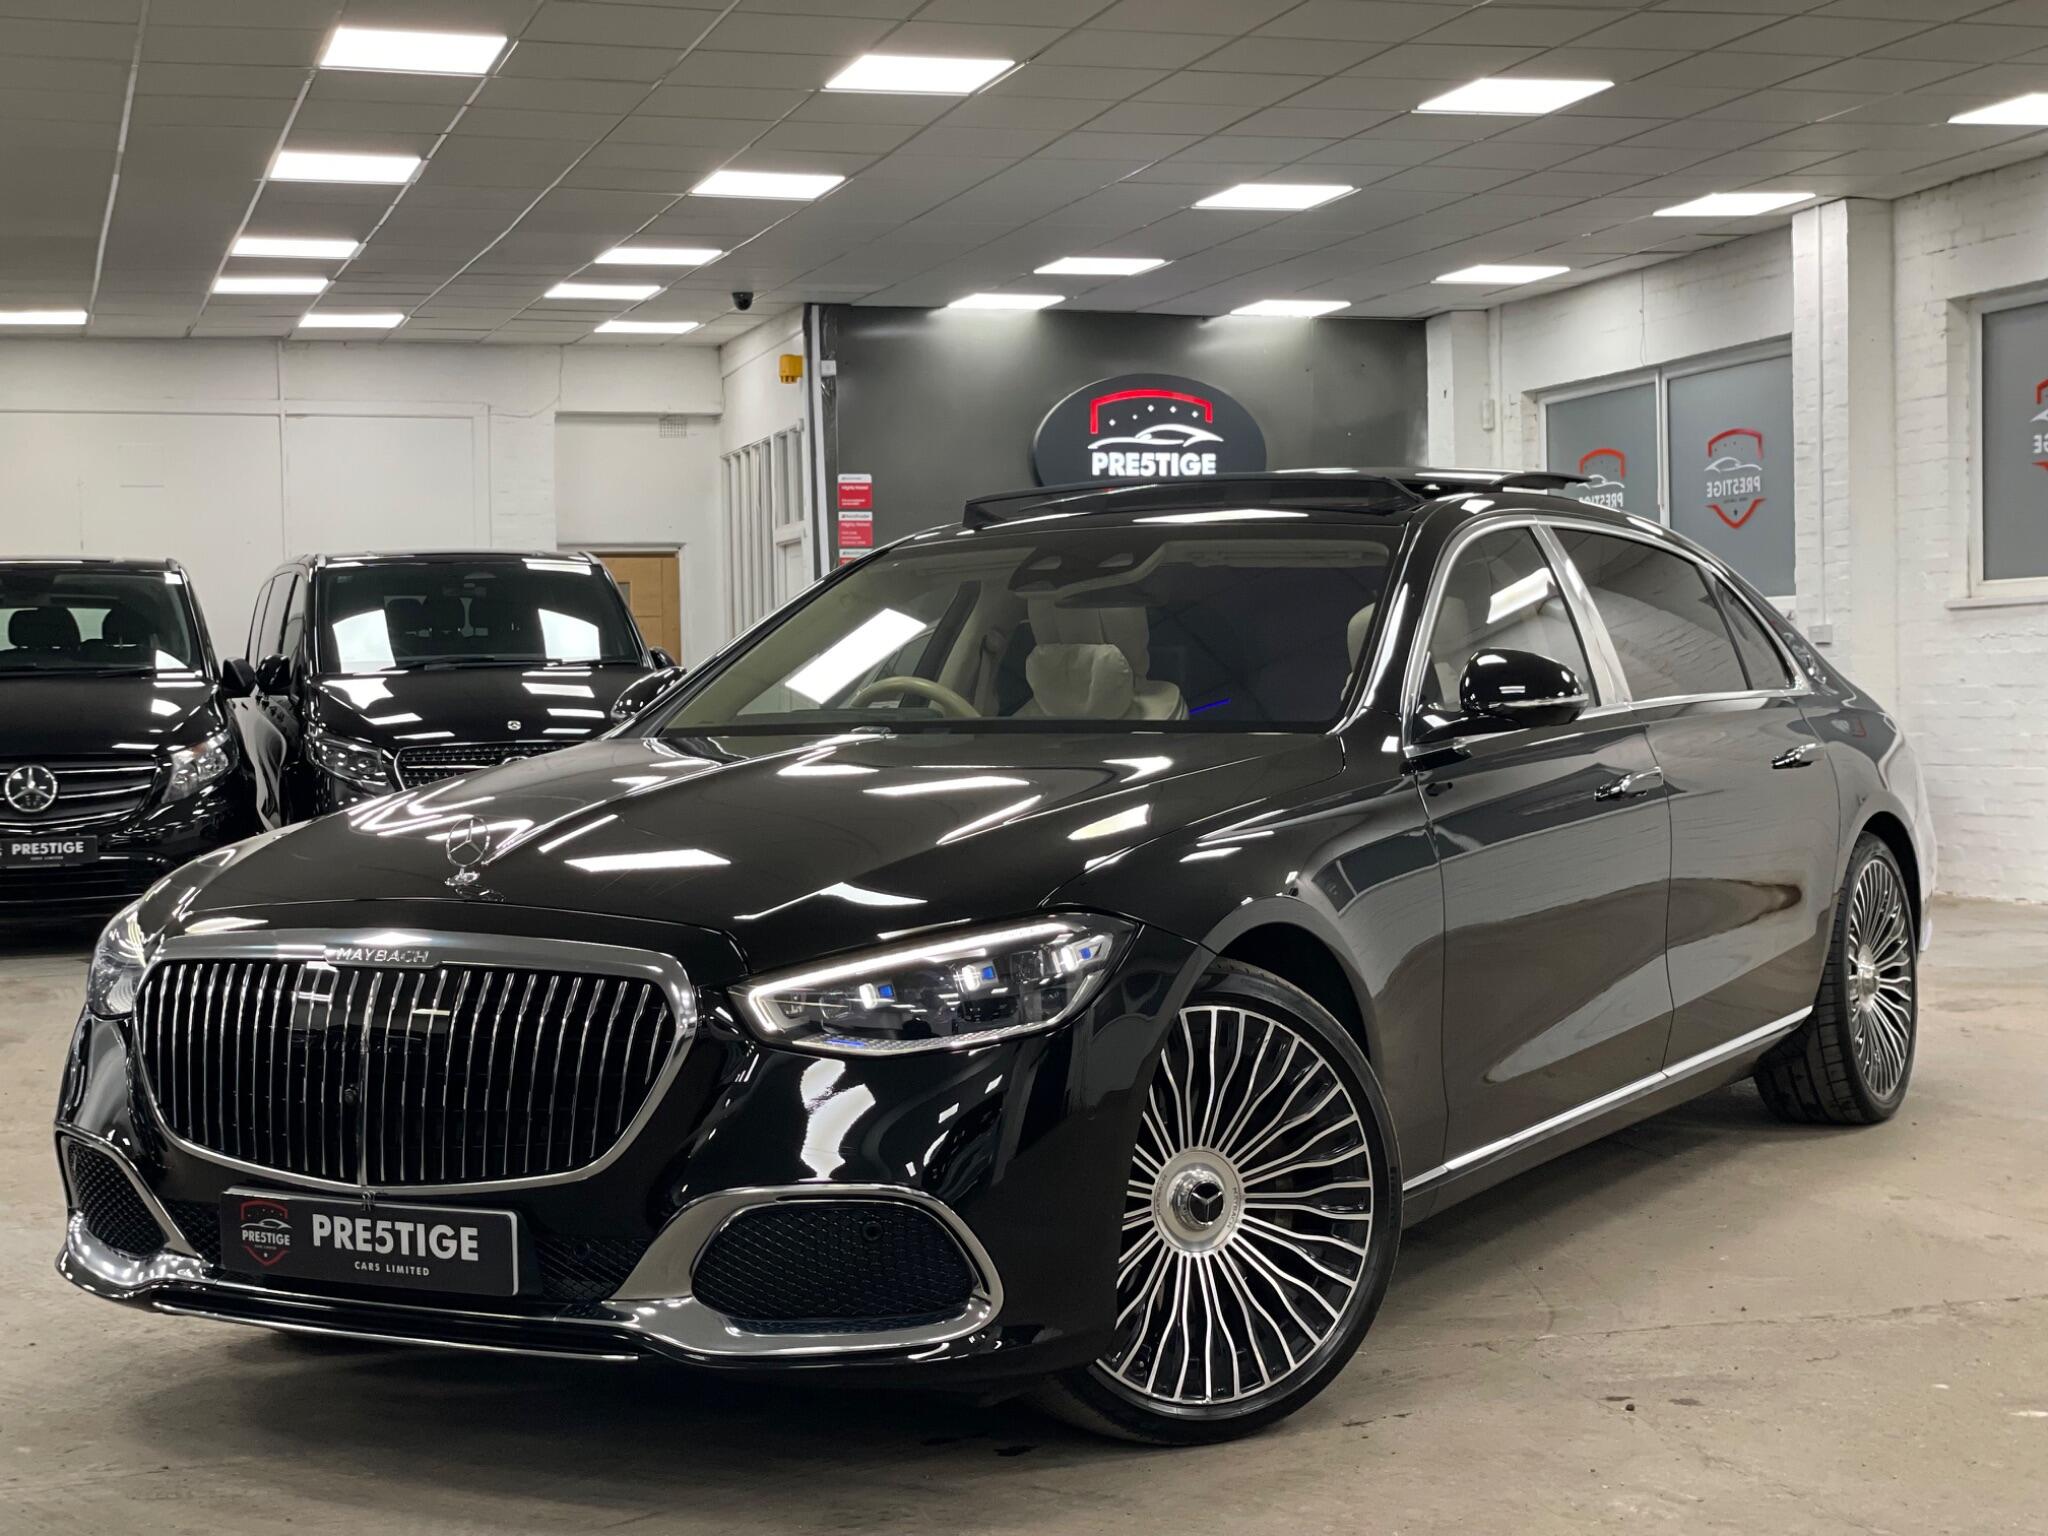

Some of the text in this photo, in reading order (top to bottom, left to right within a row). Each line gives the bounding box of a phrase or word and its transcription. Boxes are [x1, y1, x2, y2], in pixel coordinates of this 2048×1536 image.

[1092, 452, 1216, 476] PRE5TIGE
[336, 947, 429, 963] MAYBACH
[312, 1213, 479, 1261] PRE5TIGE
[354, 1261, 430, 1276] CARS LIMITED
